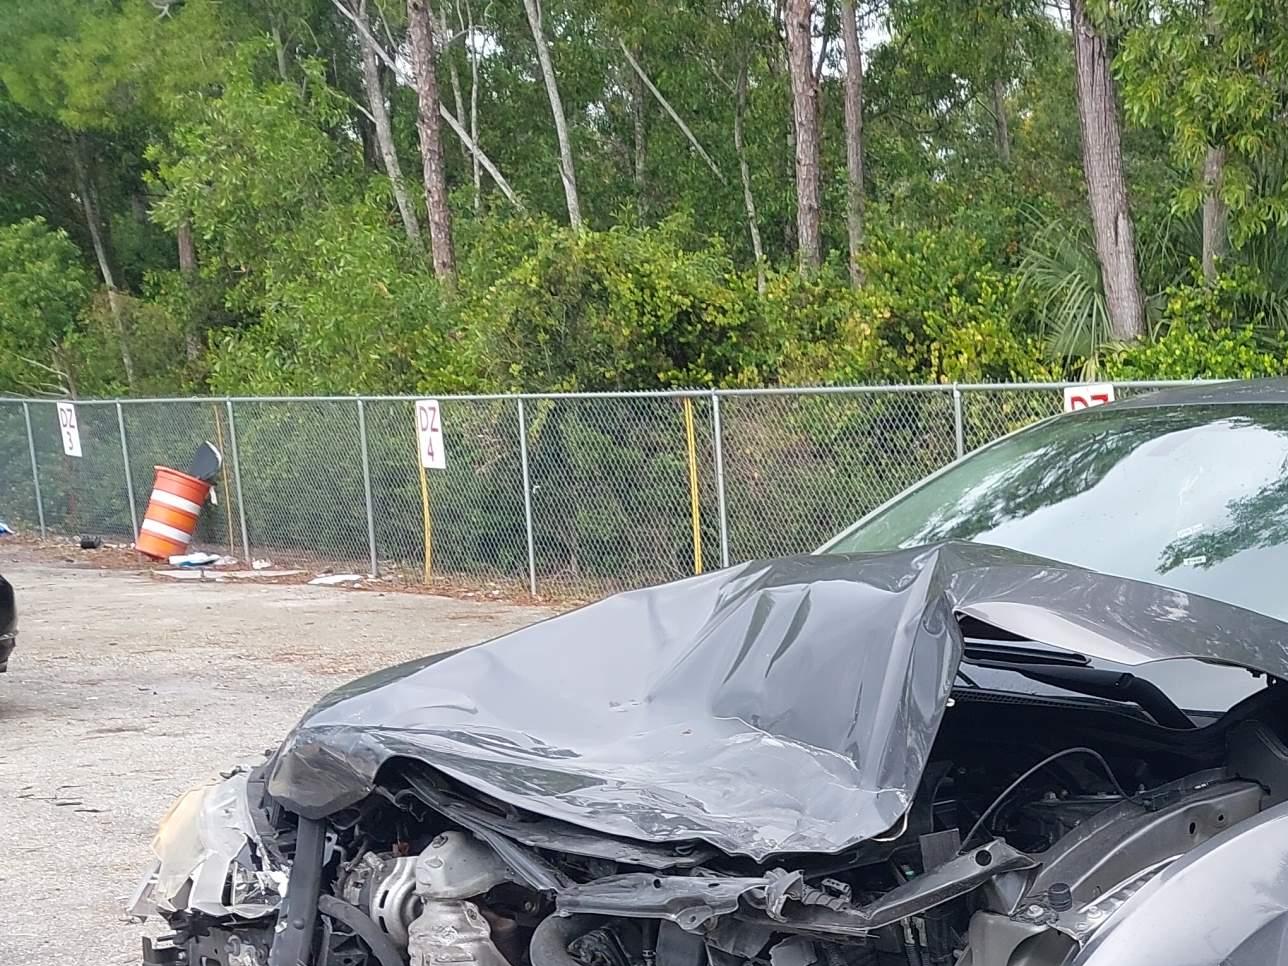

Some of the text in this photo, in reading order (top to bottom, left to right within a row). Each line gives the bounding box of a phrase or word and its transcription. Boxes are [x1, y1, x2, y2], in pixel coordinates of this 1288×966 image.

[60, 407, 75, 427] DZ
[419, 405, 439, 432] DZ
[427, 435, 435, 462] 4
